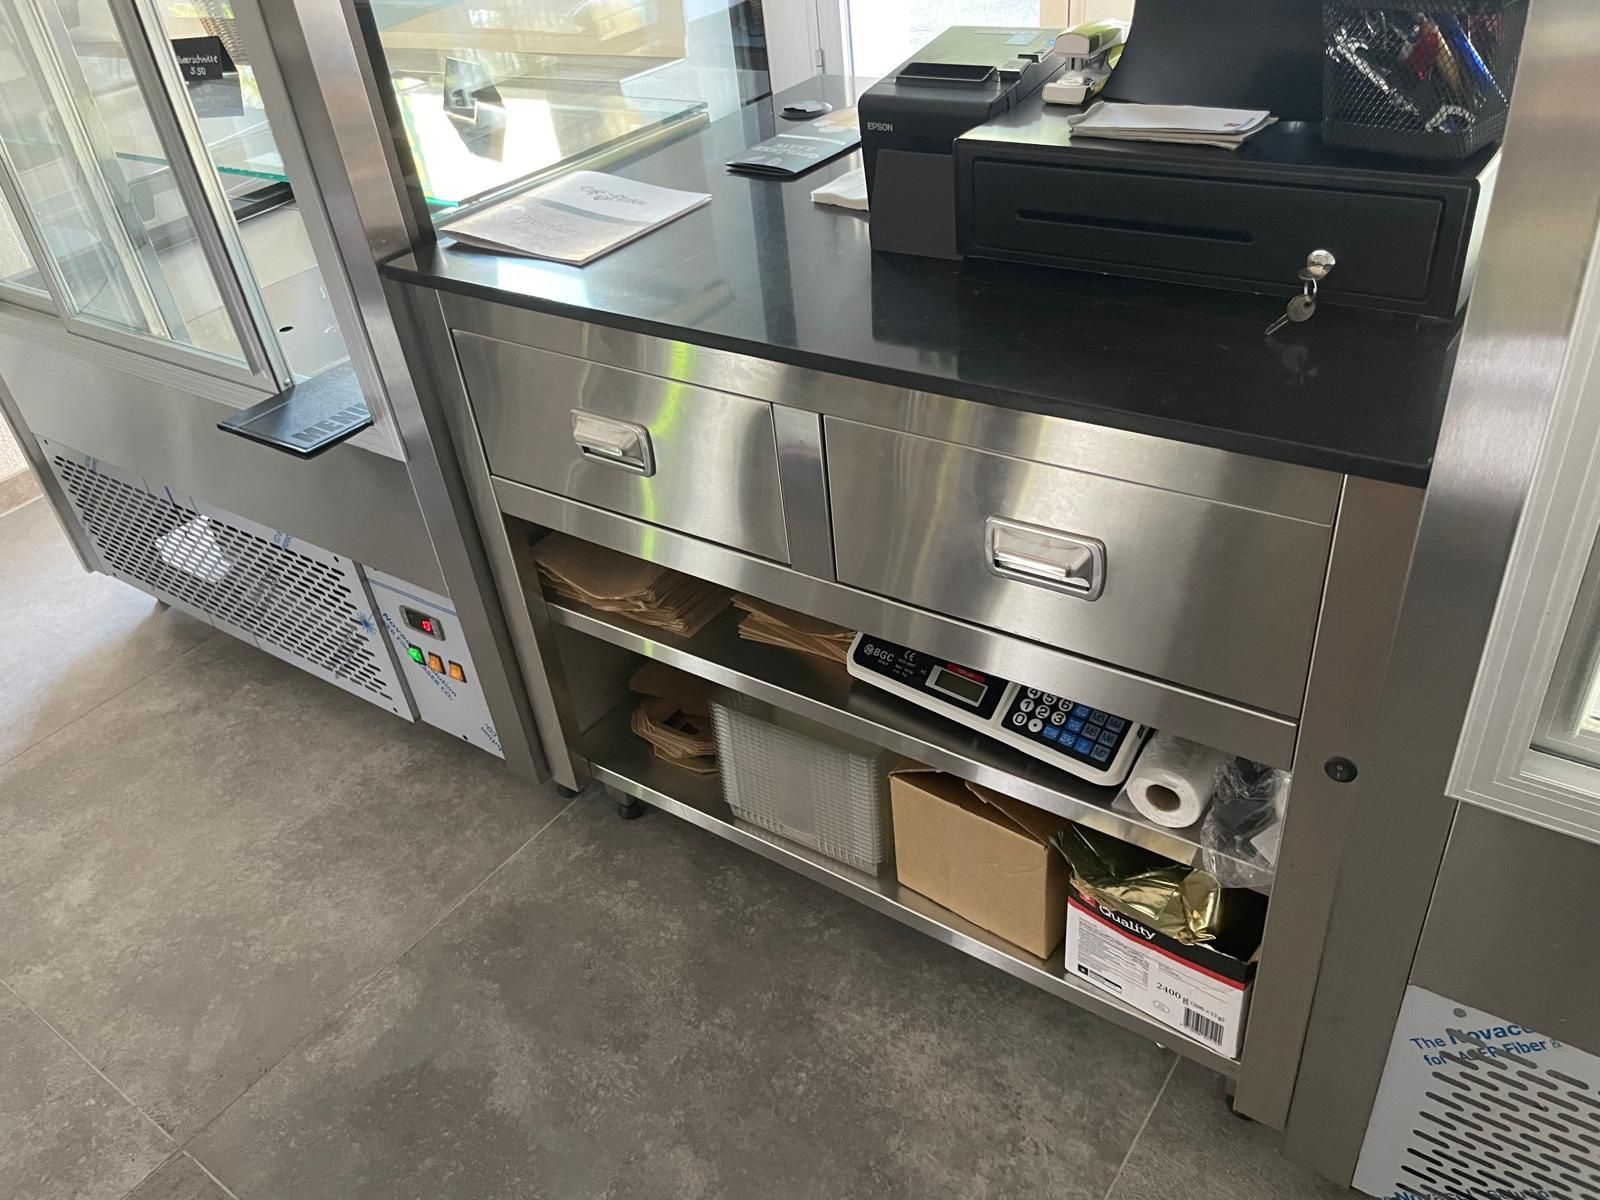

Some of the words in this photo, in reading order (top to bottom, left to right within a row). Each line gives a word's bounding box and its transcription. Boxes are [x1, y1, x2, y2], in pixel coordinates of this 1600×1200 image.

[867, 122, 893, 132] EPSON
[873, 648, 895, 663] BGC
[1061, 698, 1072, 710] 6
[1015, 713, 1025, 725] 0
[1037, 706, 1049, 718] 2
[1053, 713, 1065, 724] 3
[1099, 904, 1156, 940] Quality
[1156, 982, 1182, 1000] 2400
[1182, 997, 1189, 1005] g
[1410, 1037, 1447, 1050] The
[1503, 1040, 1546, 1054] Fiber
